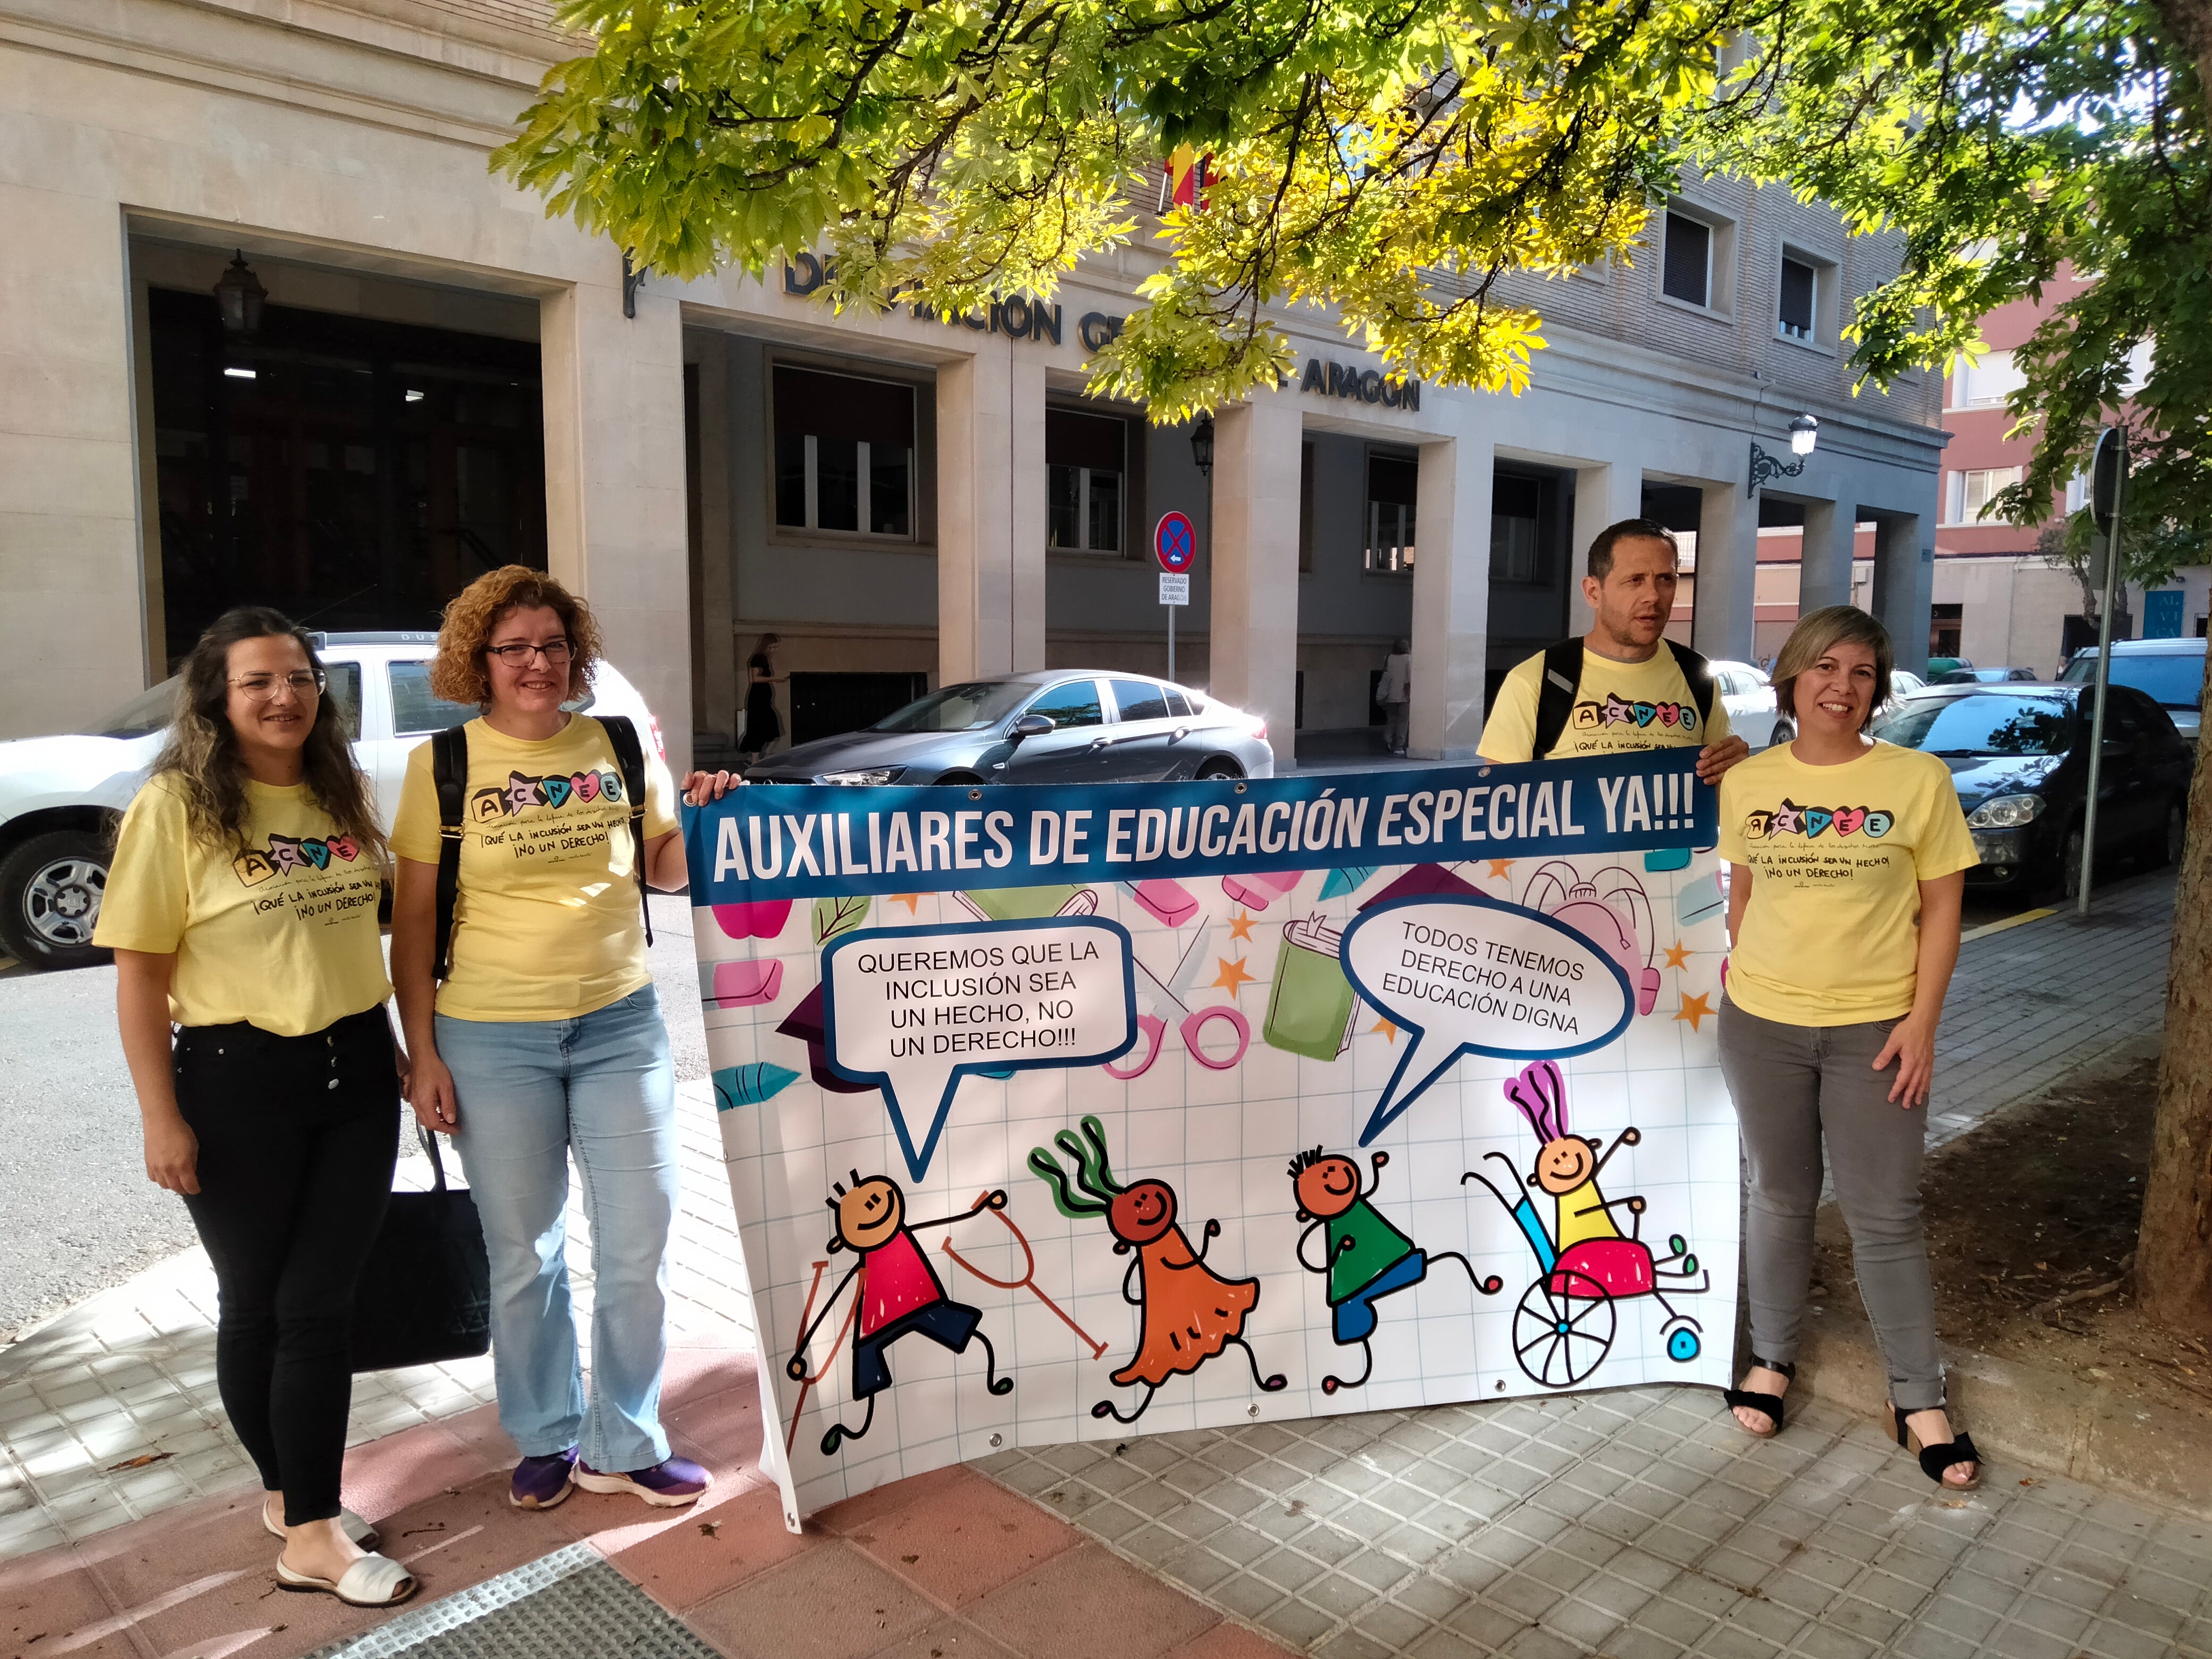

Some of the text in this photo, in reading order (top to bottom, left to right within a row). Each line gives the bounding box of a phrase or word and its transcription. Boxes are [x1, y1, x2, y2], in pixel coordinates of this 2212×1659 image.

[480, 779, 617, 818] ACNEE
[508, 832, 524, 842] LA
[539, 840, 556, 852] UN
[561, 831, 610, 850] DERECHO!
[714, 772, 1694, 883] AUXILIARES DE EDUCACIÓN ESPECIAL YA!!!
[1761, 856, 1773, 865] LA
[1786, 868, 1801, 877] UN
[1805, 868, 1854, 881] DERECHO!
[288, 891, 305, 903] LA
[349, 882, 362, 890] SEA
[318, 900, 332, 914] UN
[858, 941, 1100, 974] QUEREMOS QUE LA
[1402, 921, 1585, 981] TODOS TENEMOS
[886, 970, 1077, 1001] INCLUSIÓN SEA
[1401, 949, 1572, 1007] DERECHO A UNA
[891, 1000, 1074, 1029] UN HECHO, NO
[1382, 972, 1579, 1036] EDUCACIÓN DIGNA
[890, 1027, 1076, 1058] UN DERECHO!!!
